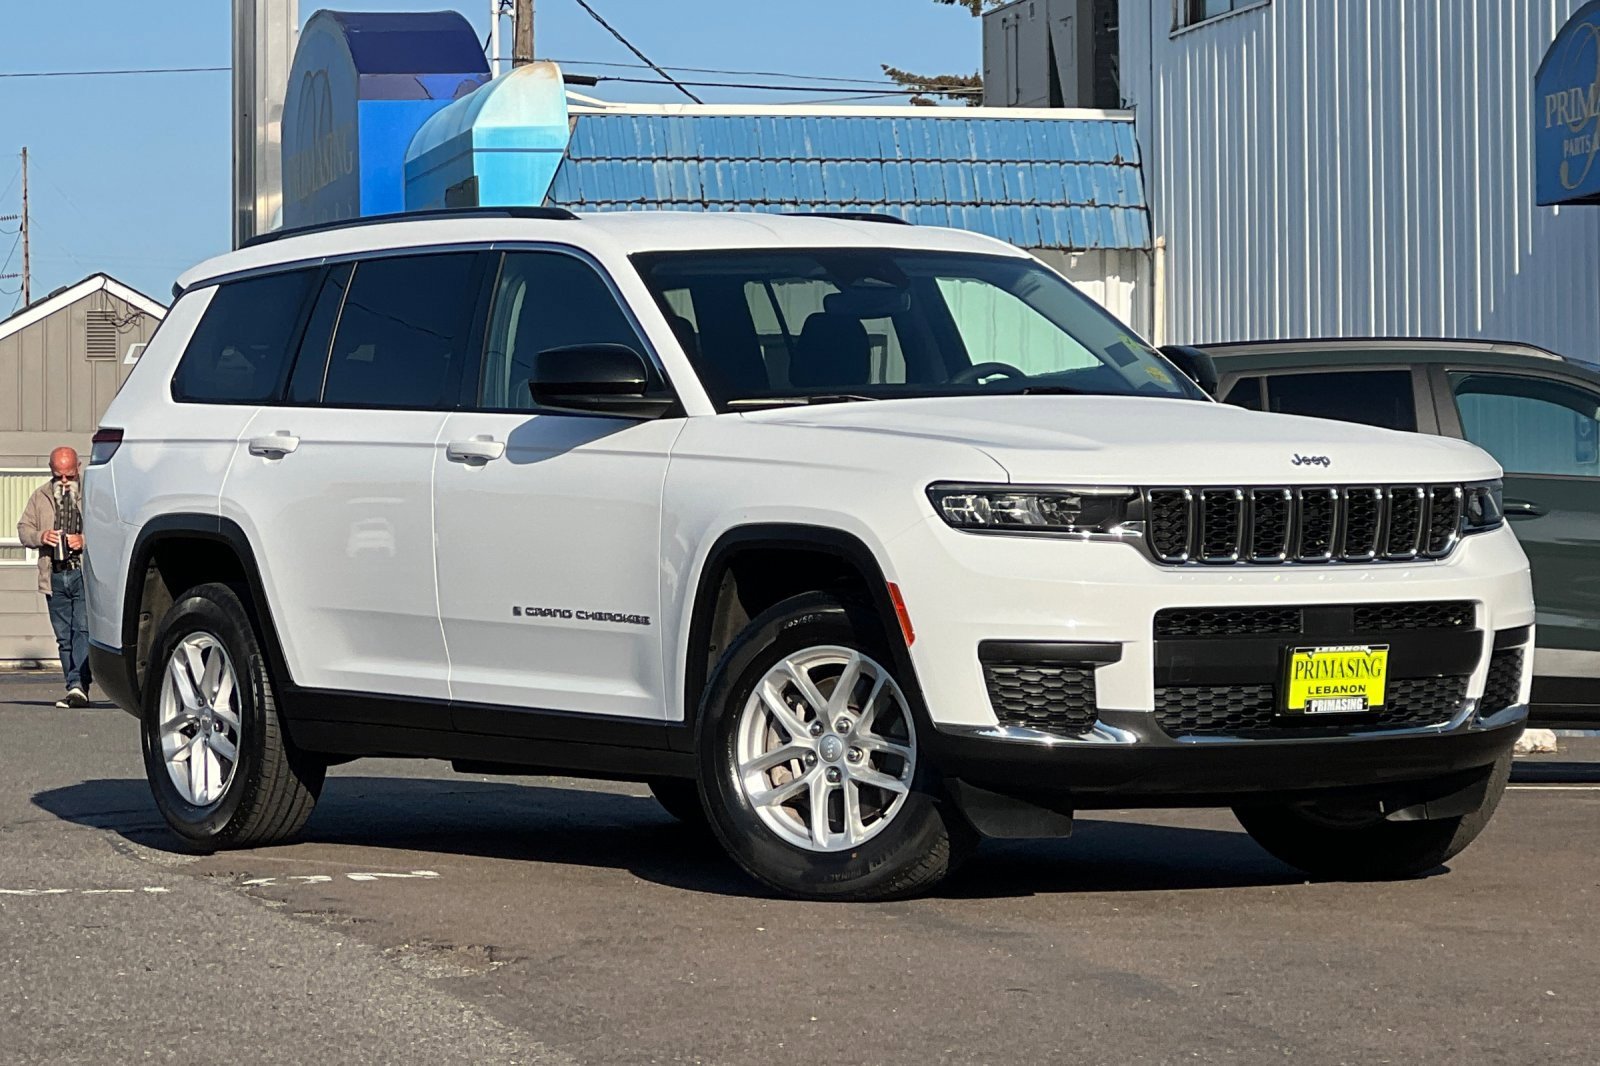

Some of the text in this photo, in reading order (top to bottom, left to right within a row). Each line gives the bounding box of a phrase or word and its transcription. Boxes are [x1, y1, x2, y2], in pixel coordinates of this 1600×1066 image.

[1291, 453, 1331, 468] Jeep
[525, 607, 651, 626] GRAND CHEROKEE
[1315, 645, 1369, 653] LEBANON
[1295, 657, 1382, 680] PRIMASING
[1307, 685, 1366, 694] LEBANON
[1311, 697, 1364, 712] PRIMASING
